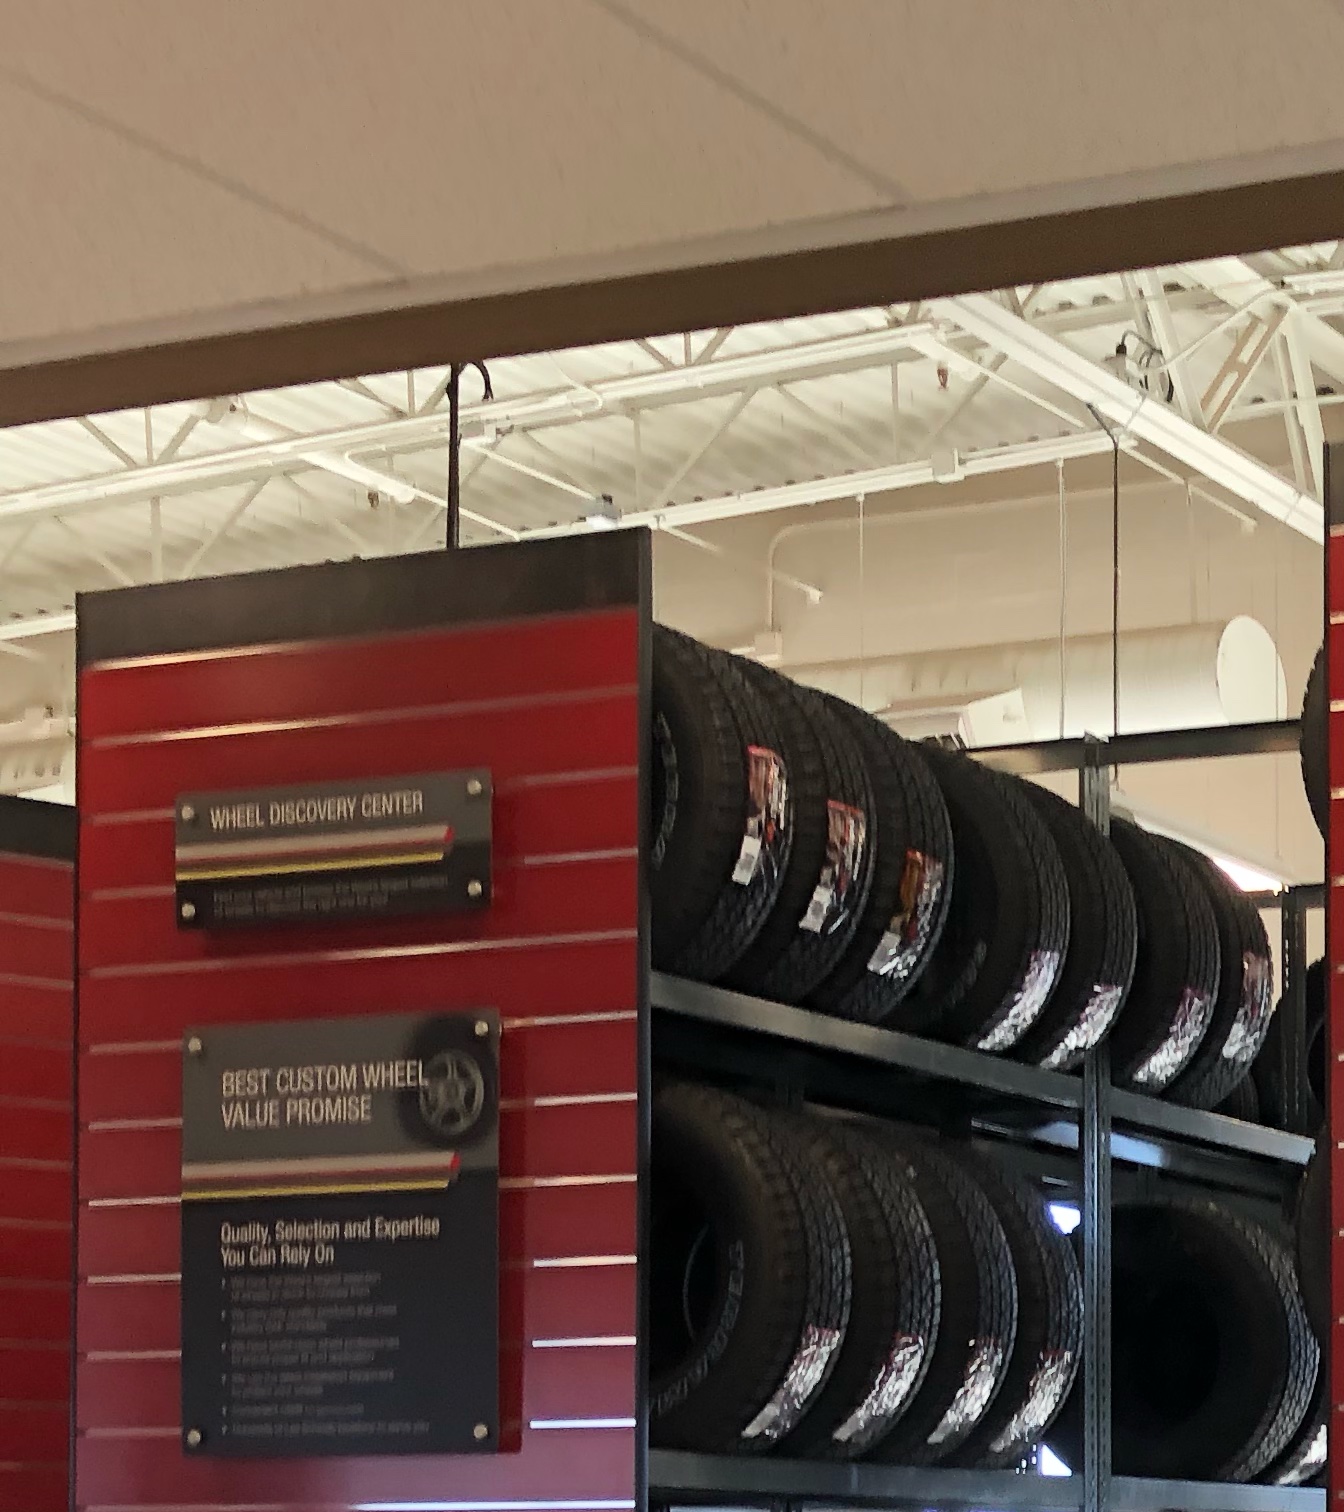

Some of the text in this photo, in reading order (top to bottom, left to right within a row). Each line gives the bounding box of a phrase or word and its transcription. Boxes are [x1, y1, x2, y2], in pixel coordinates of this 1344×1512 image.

[210, 790, 423, 832] WHEEL DISCOVERY CENTER
[222, 1059, 429, 1097] BEST CUSTOM WHEEL
[221, 1095, 372, 1130] VALUE PROMISE
[221, 1215, 440, 1245] Quality, Selection and Expertise
[221, 1243, 334, 1268] You Can Rely On
